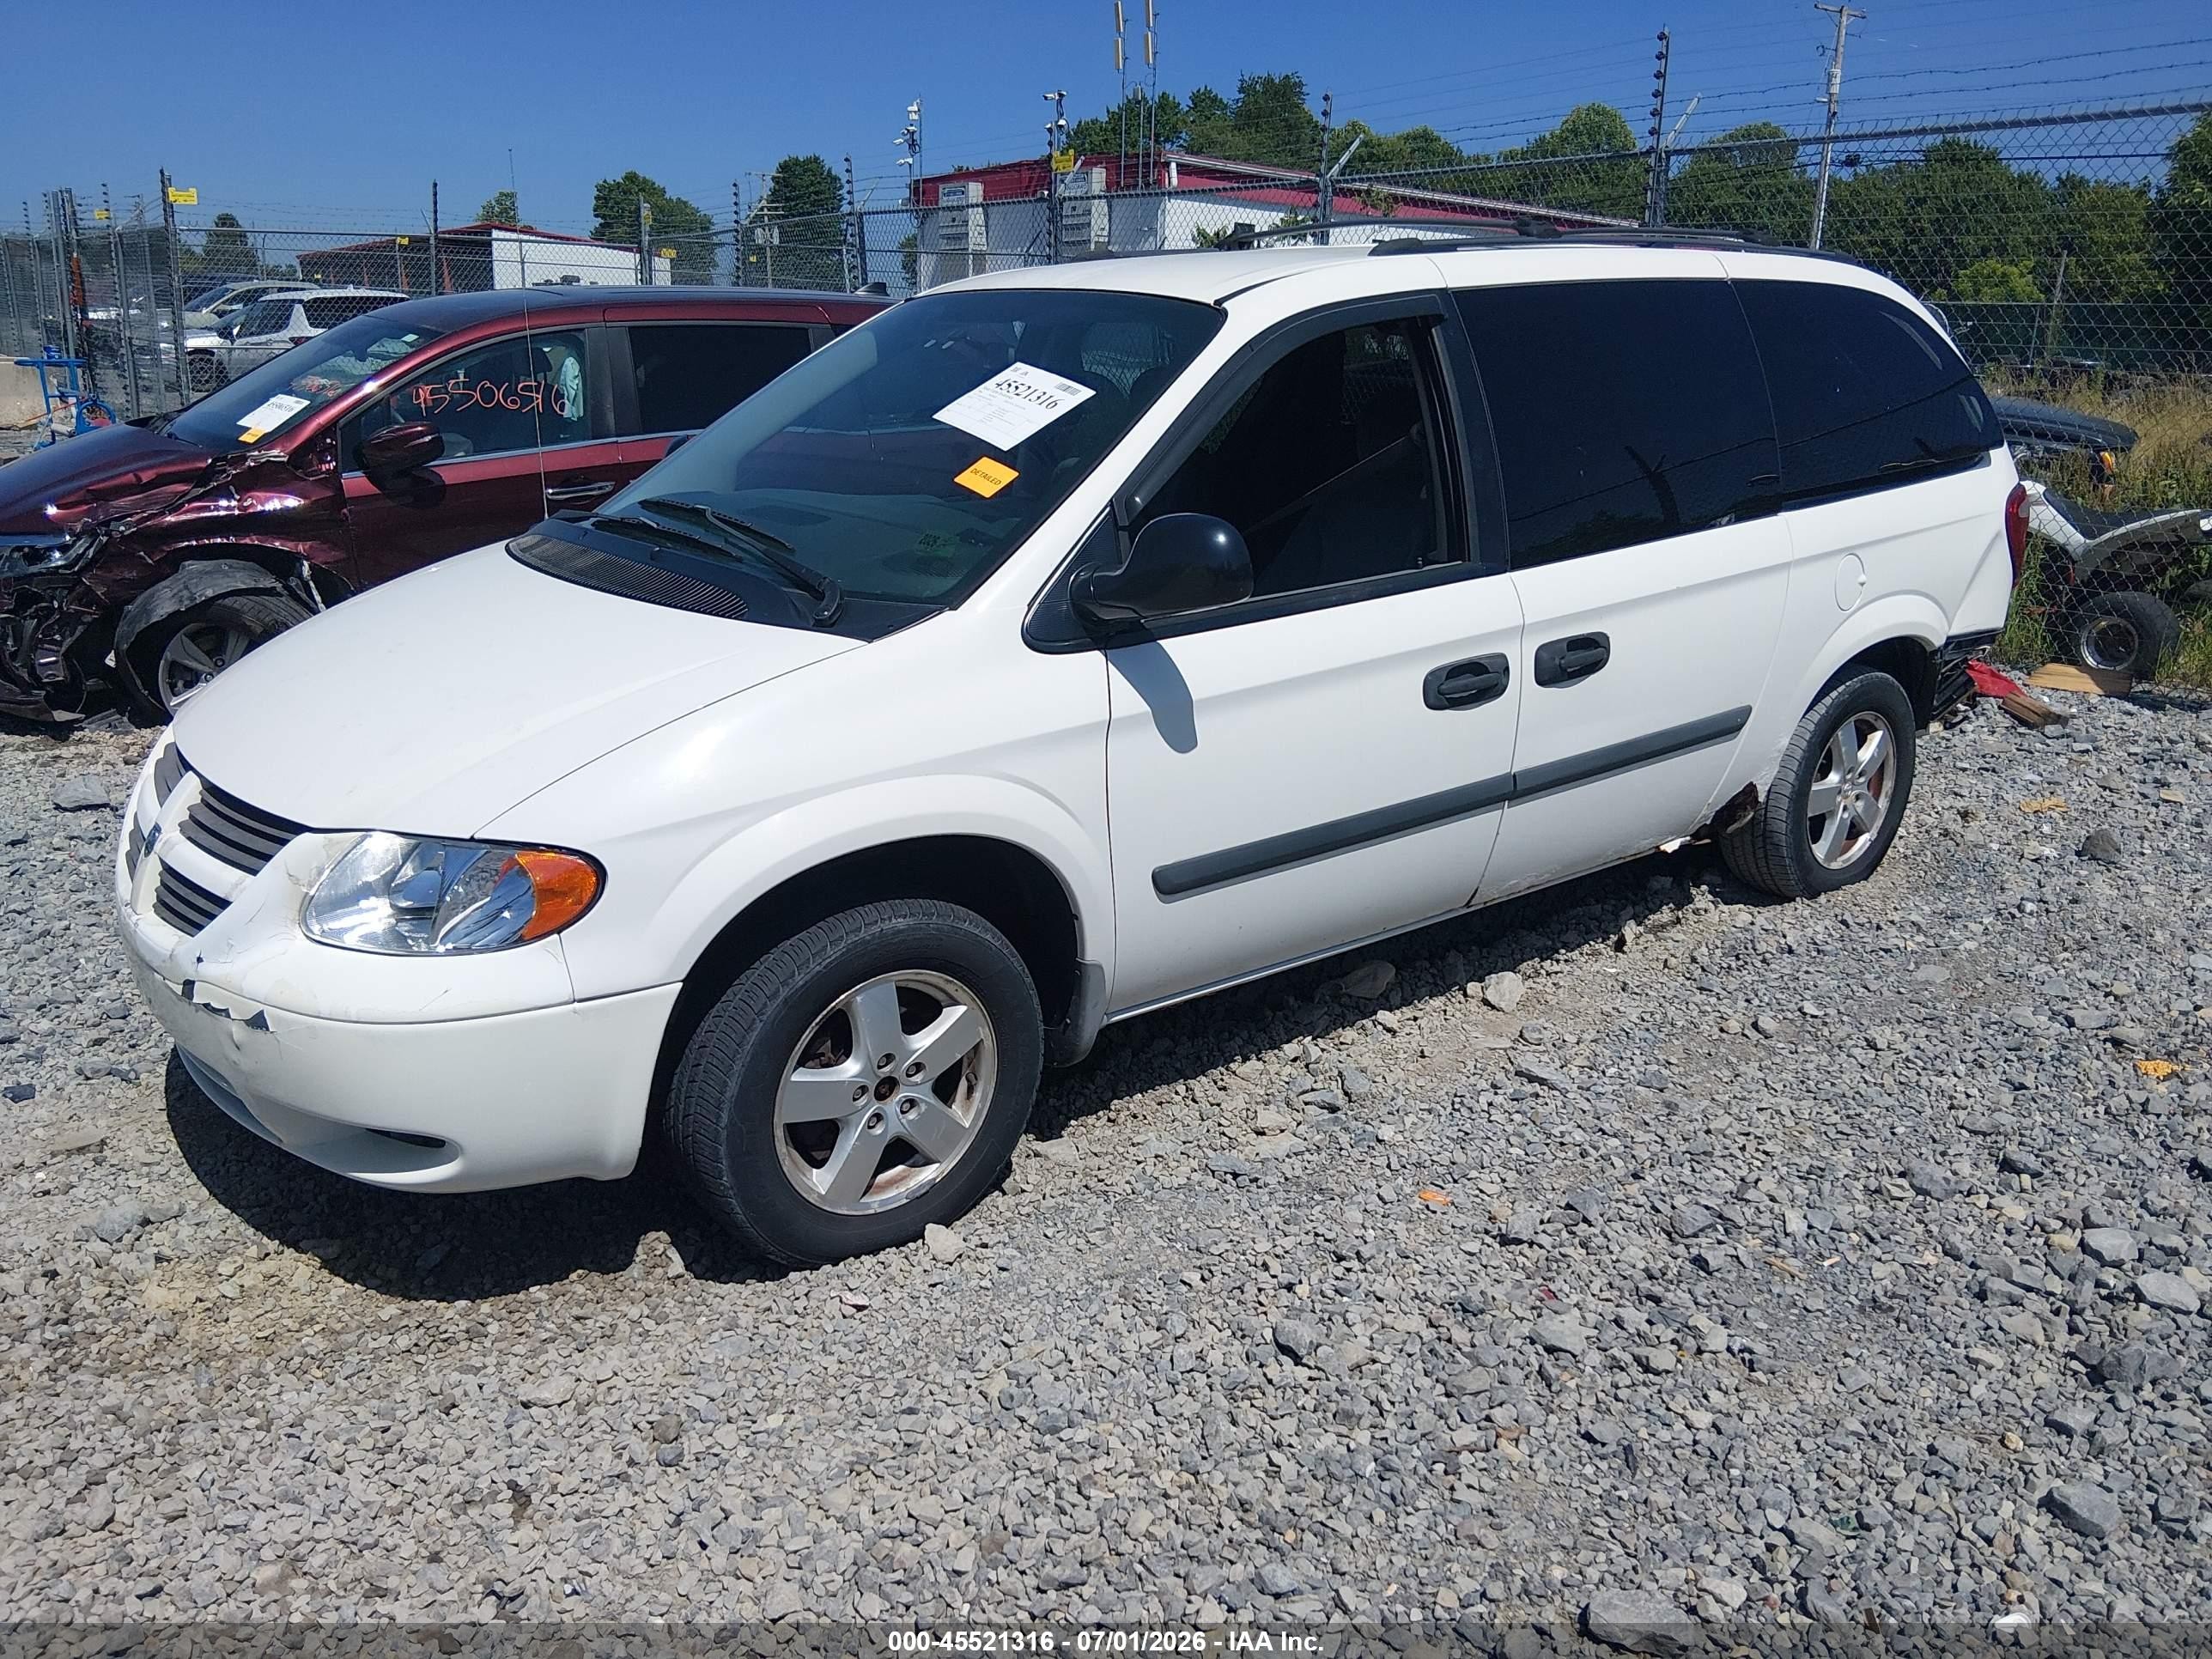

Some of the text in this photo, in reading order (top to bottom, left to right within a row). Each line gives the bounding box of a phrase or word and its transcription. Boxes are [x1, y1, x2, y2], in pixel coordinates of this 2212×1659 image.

[413, 378, 568, 416] 45506516
[994, 378, 1065, 410] 45521316
[969, 468, 1002, 486] DETAILED
